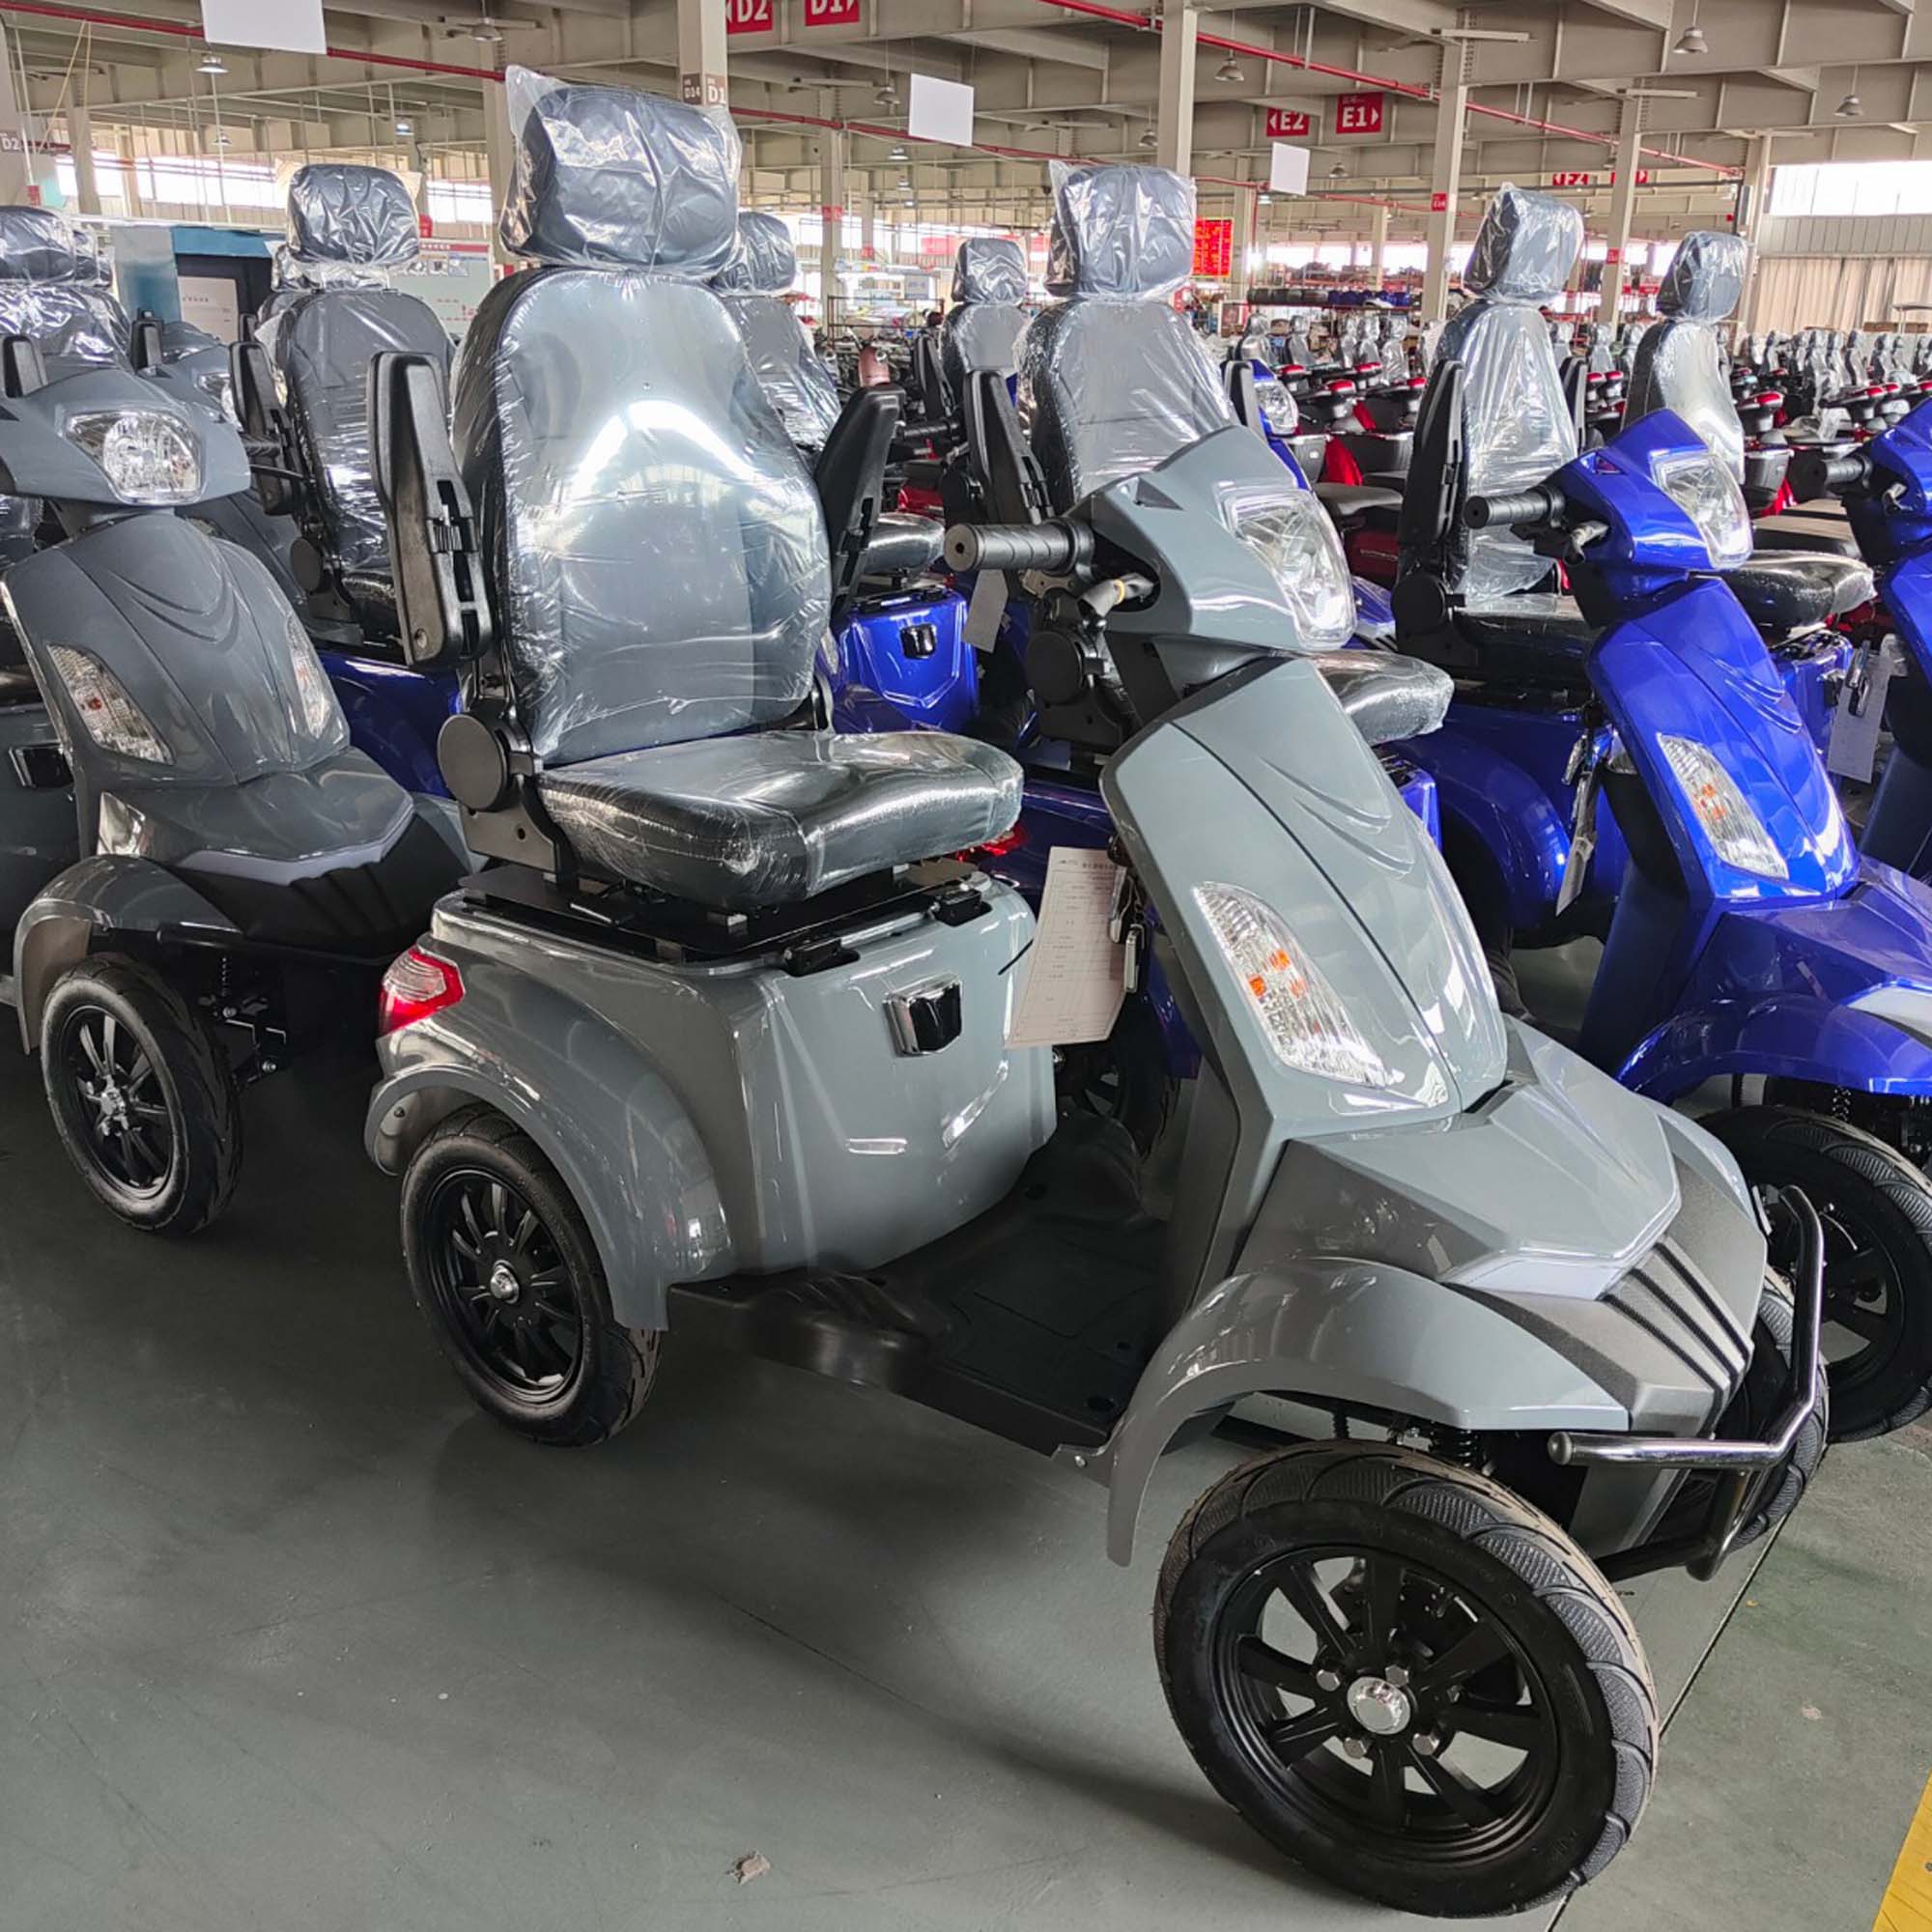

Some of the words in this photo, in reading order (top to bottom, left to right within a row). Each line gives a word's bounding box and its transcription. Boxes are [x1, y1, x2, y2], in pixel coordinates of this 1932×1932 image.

[737, 0, 769, 22] D2
[1280, 110, 1304, 130] E2
[1342, 106, 1367, 128] E1
